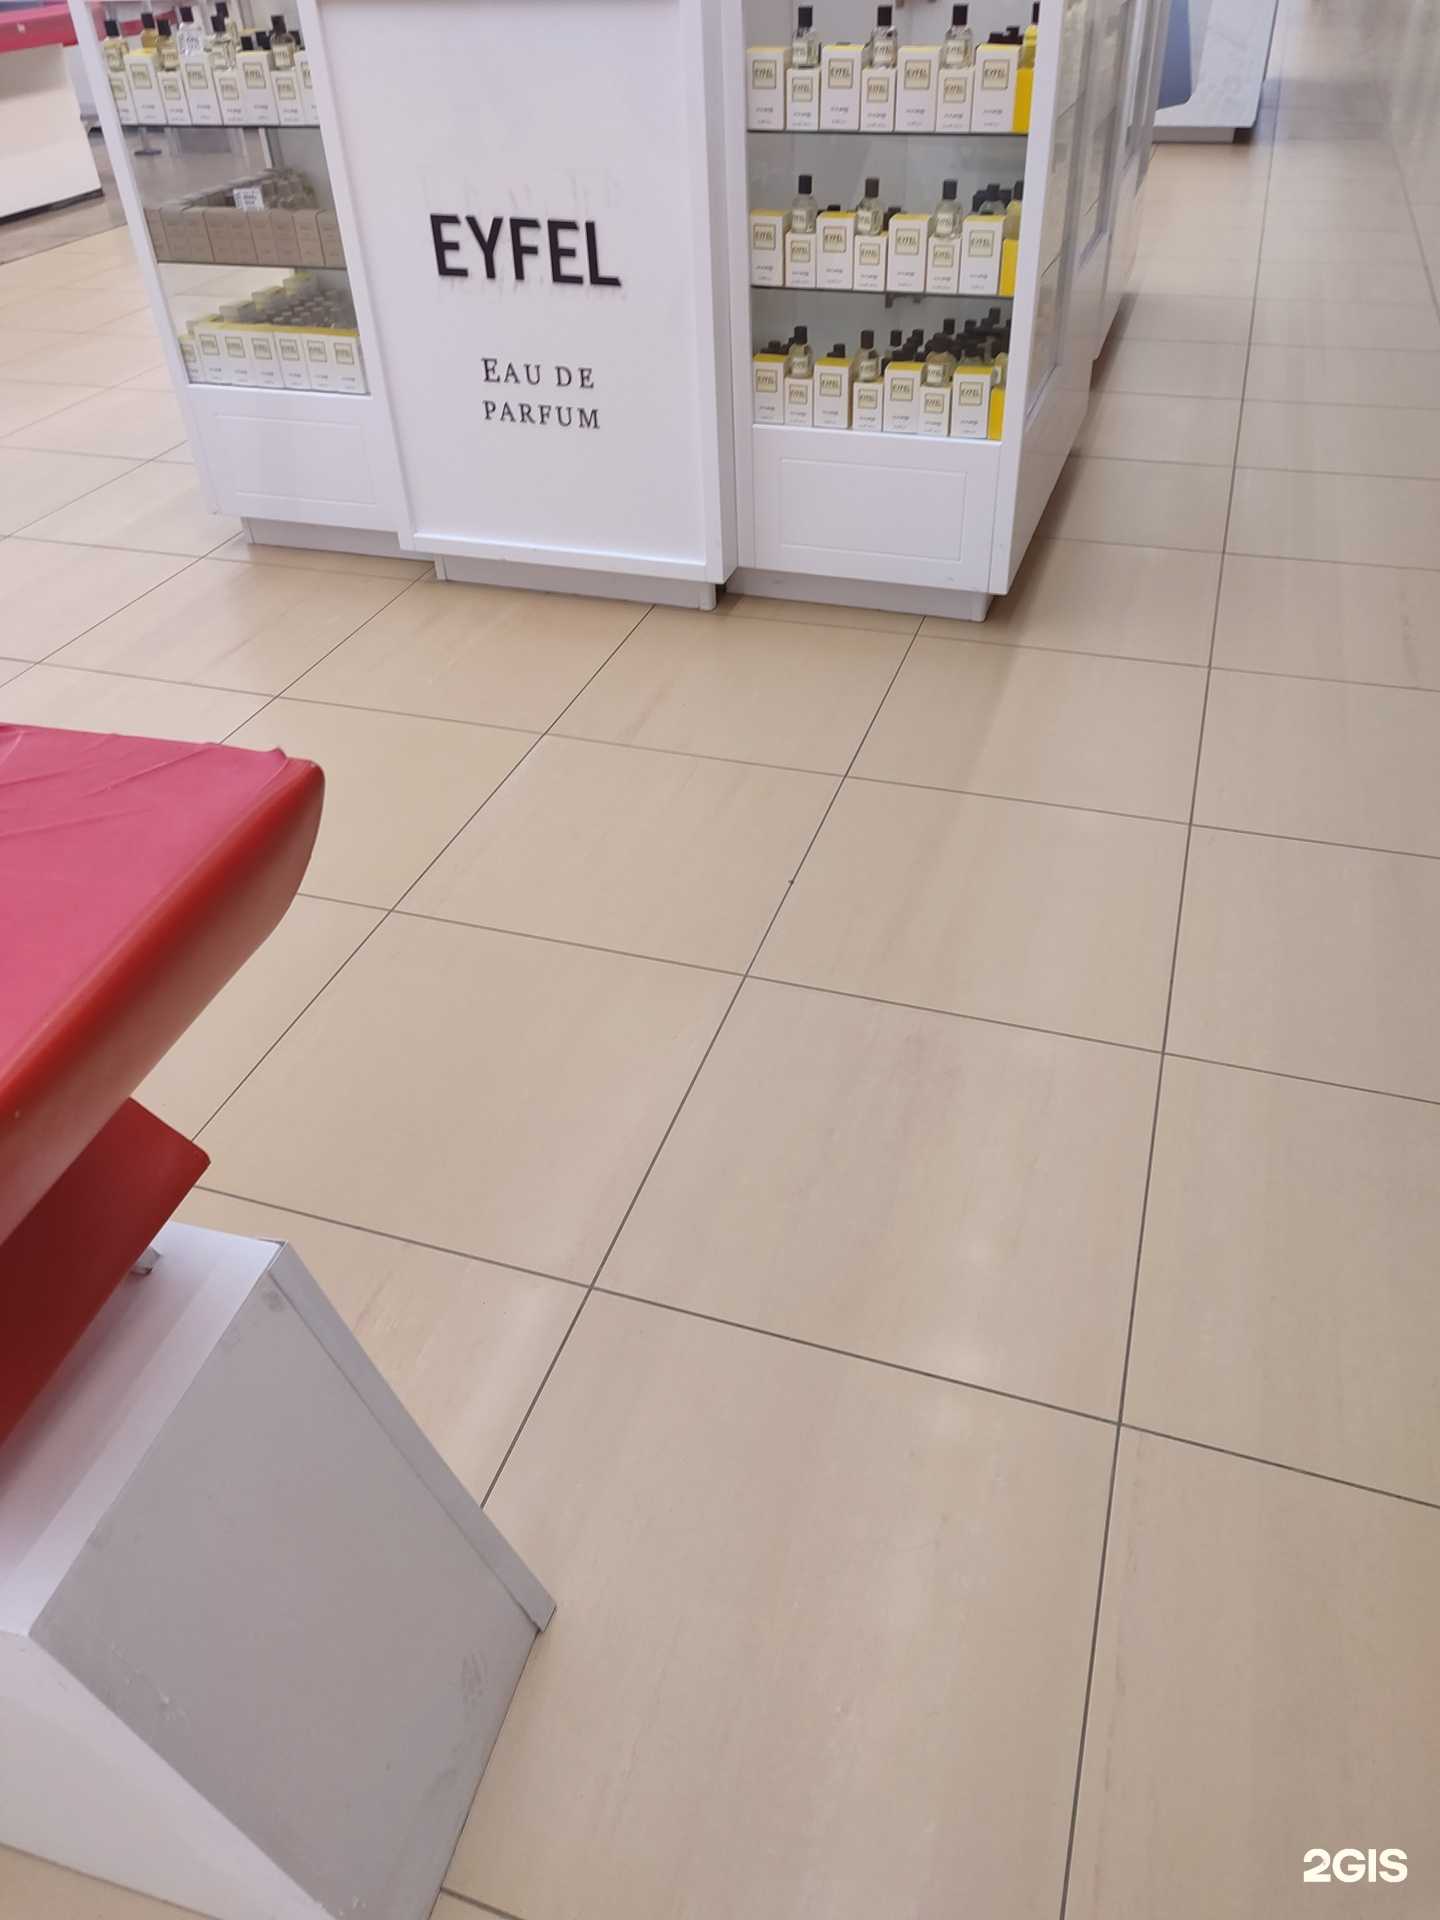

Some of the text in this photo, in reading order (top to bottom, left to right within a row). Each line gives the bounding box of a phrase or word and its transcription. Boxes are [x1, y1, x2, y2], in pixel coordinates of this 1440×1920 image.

[430, 213, 622, 287] EYFEL
[481, 357, 595, 389] EAU DE
[482, 400, 601, 430] PARFUM
